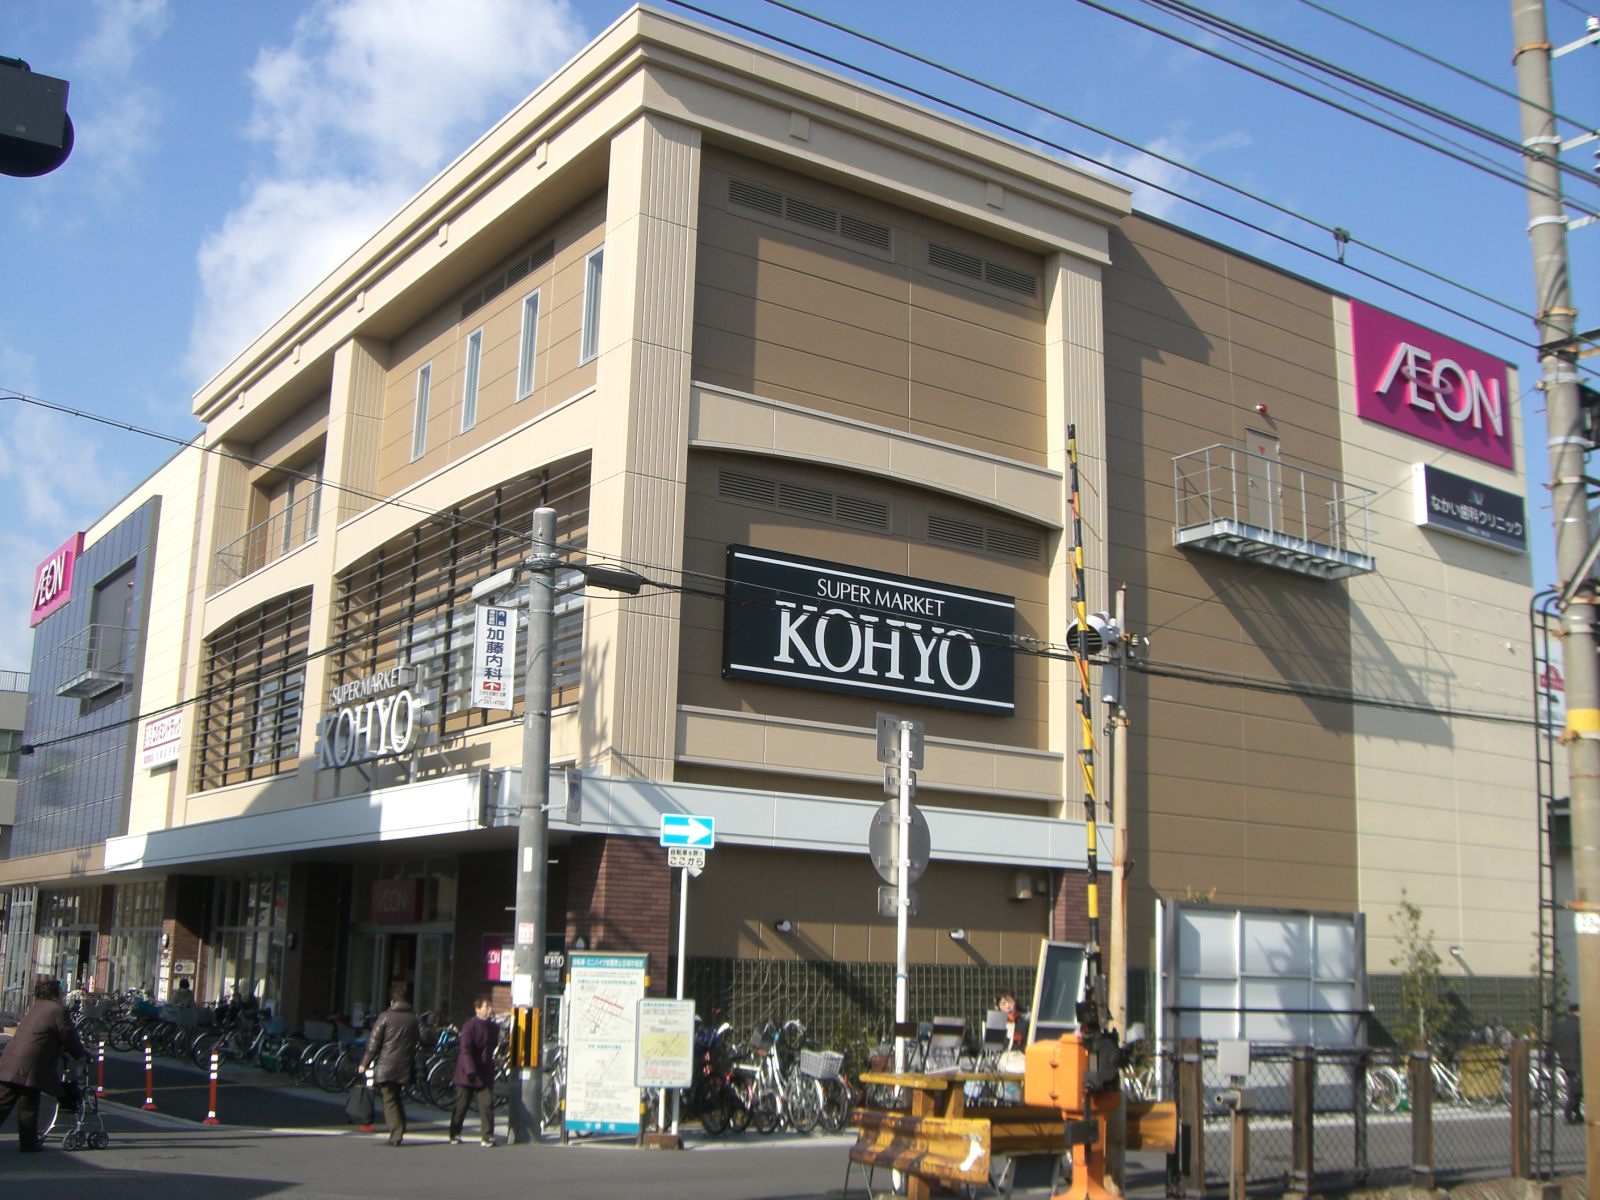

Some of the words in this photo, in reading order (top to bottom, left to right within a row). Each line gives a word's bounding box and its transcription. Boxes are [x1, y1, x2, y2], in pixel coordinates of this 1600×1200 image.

[1431, 496, 1523, 536] なかい歯科クリニック
[817, 578, 871, 605] SUPER
[875, 589, 944, 617] MARKET
[484, 627, 505, 681] 加藤内科
[774, 600, 981, 691] KOHYO
[332, 680, 360, 706] SUPER
[360, 666, 402, 698] MARKET
[315, 690, 413, 769] KOHYO
[670, 857, 704, 867] ここから
